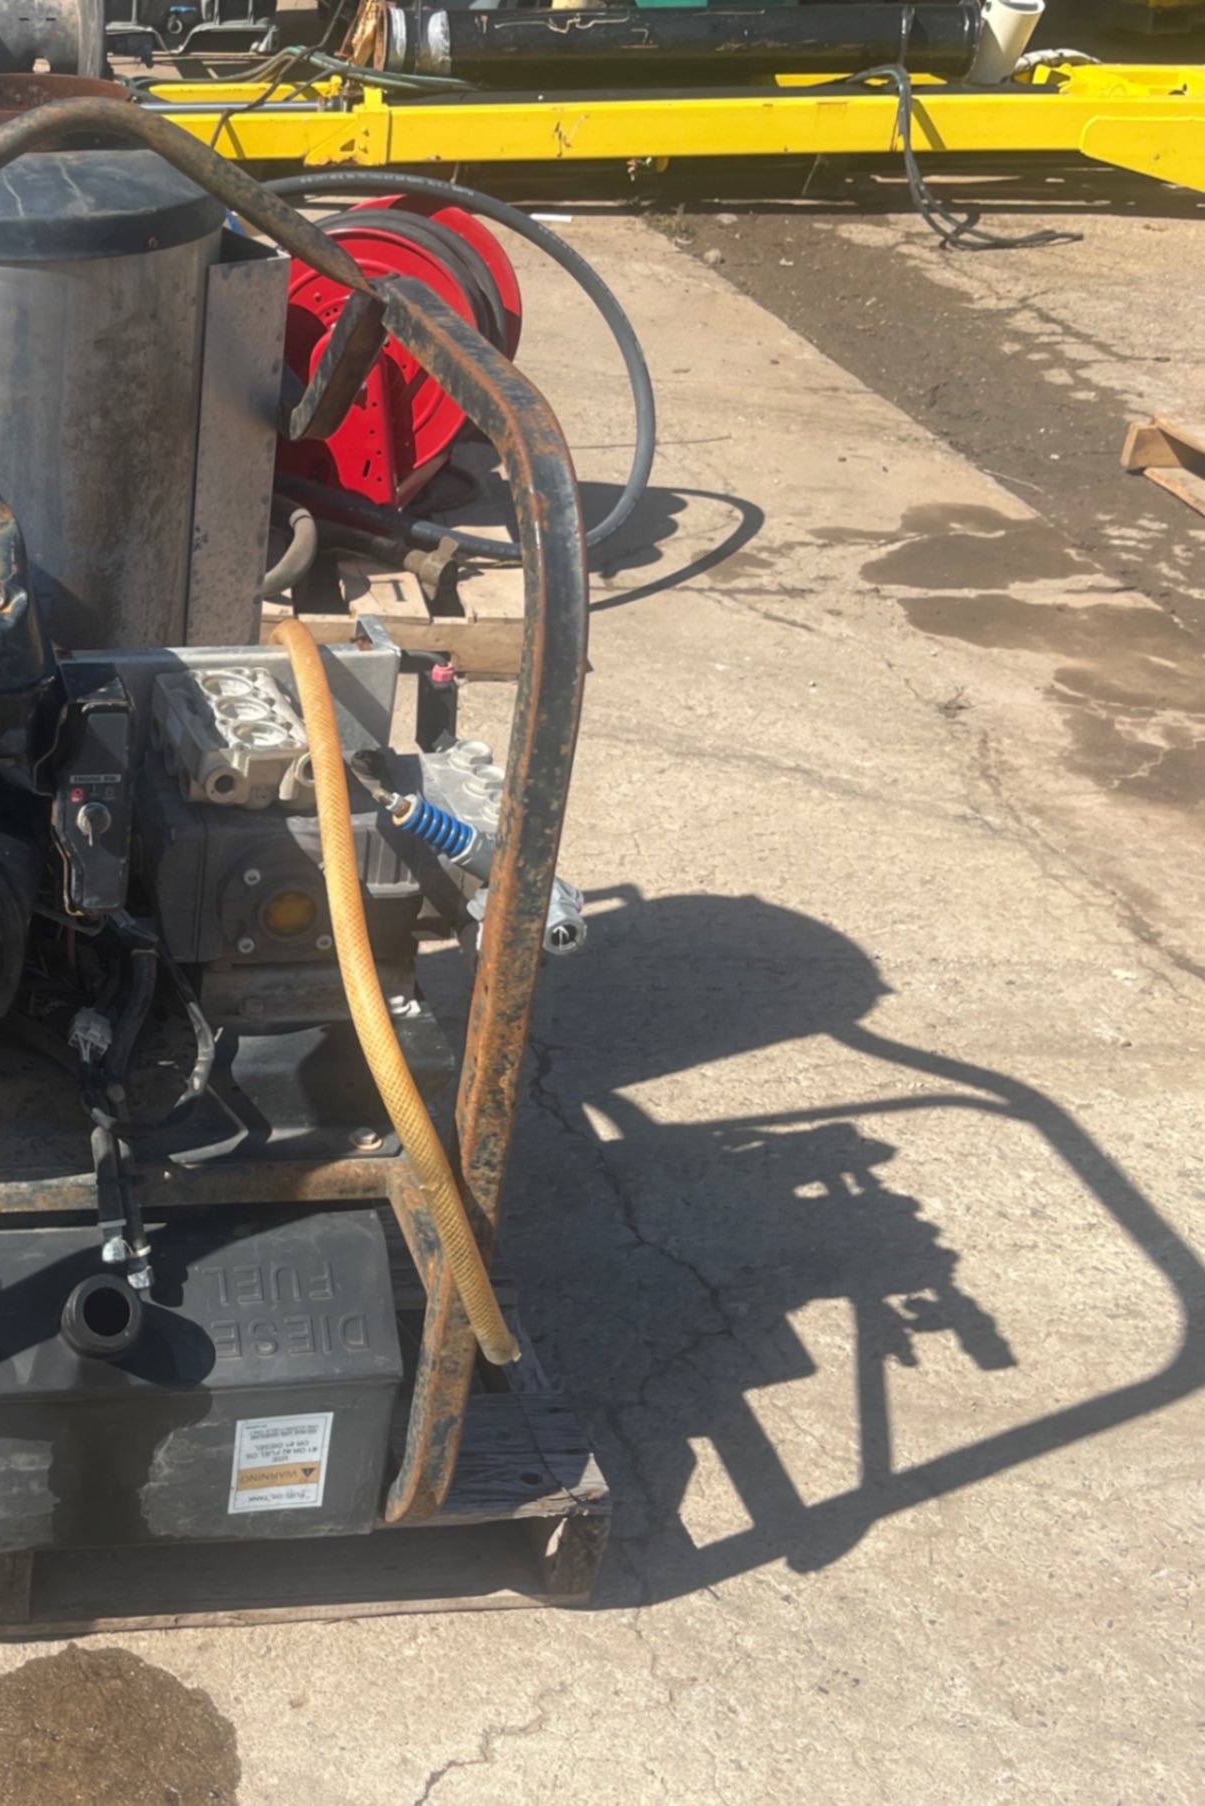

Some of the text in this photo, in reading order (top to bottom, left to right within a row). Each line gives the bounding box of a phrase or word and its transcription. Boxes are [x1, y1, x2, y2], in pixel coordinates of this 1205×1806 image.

[202, 1262, 335, 1306] FUEL
[209, 1312, 371, 1361] DIESE
[240, 1470, 297, 1484] WARNING
